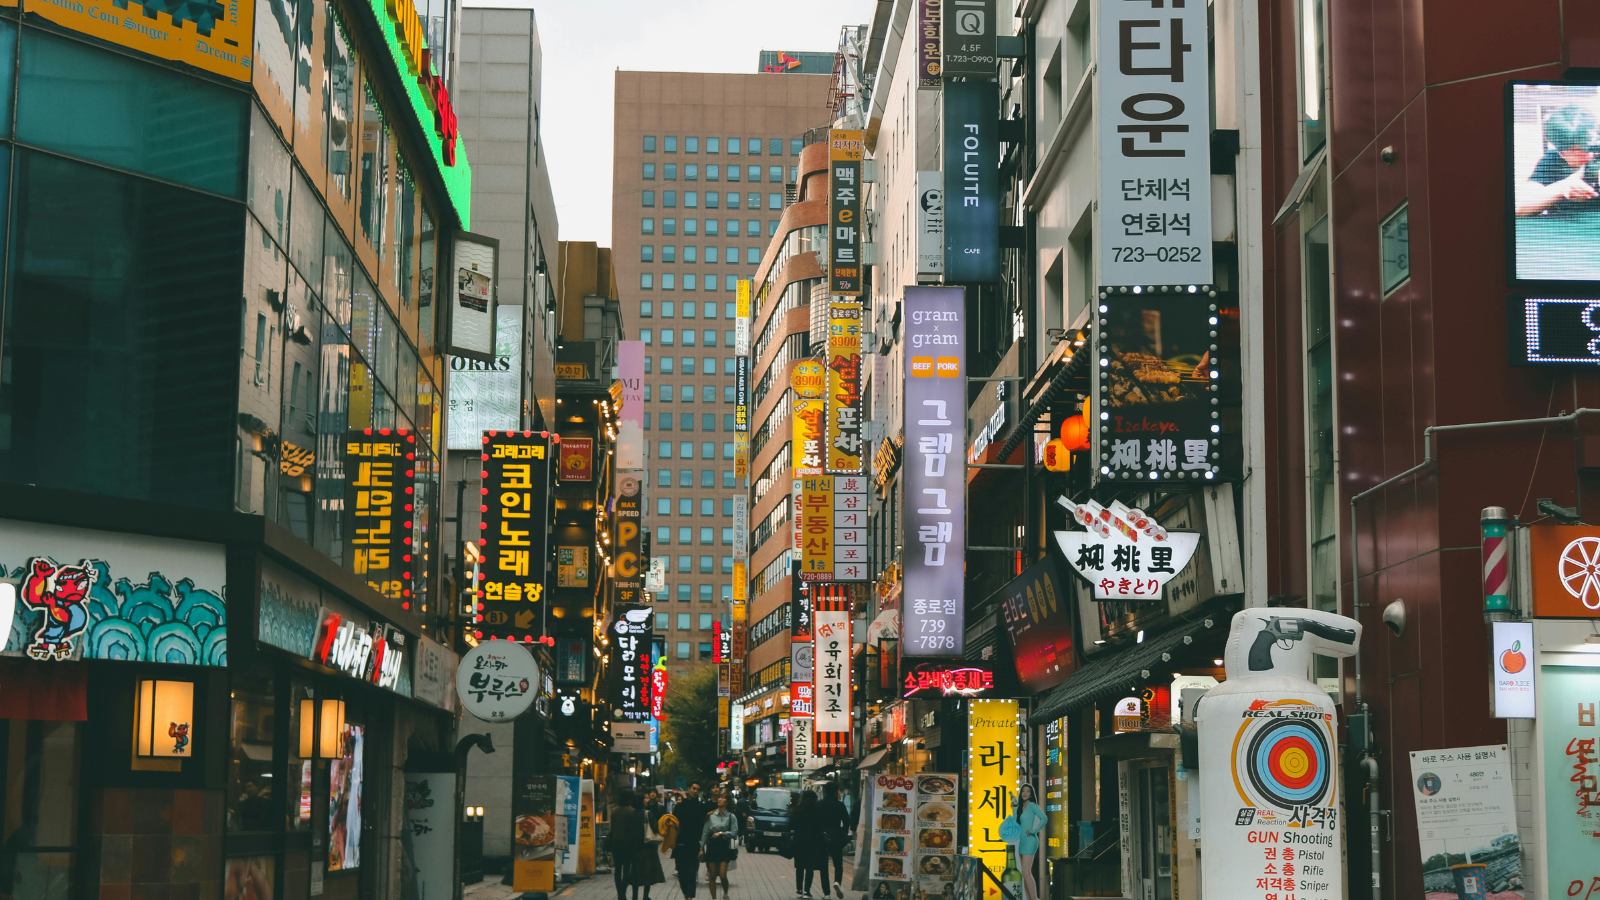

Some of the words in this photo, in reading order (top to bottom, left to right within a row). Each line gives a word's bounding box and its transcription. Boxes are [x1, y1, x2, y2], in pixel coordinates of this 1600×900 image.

[88, 6, 119, 26] Coin
[123, 17, 169, 42] Singer
[196, 39, 238, 64] Dream
[960, 44, 981, 52] 4.5F
[946, 55, 994, 63] T.723-0990
[1117, 0, 1192, 158] 타운
[833, 140, 861, 150] 최저가
[963, 124, 980, 208] FOLUITE
[1121, 178, 1190, 201] 단체석
[835, 167, 857, 263] 맥주e마트
[1121, 212, 1191, 236] 연회석
[1111, 246, 1202, 263] 723-0252
[912, 310, 959, 325] gram
[912, 333, 959, 348] gram
[913, 362, 932, 370] BEEF
[937, 362, 958, 370] PORK
[492, 444, 545, 460] 고래고래
[805, 479, 831, 492] 대신
[917, 400, 953, 566] 그램그램
[498, 464, 533, 576] 코인노래
[805, 495, 829, 556] 부동산
[485, 581, 543, 602] 연습장
[1098, 577, 1160, 596] やきとり
[621, 591, 633, 600] 3F
[913, 599, 956, 615] 종로점
[920, 620, 946, 633] 739
[913, 636, 955, 649] -7878
[824, 641, 842, 718] 육회지존
[972, 716, 1016, 728] Private
[1118, 717, 1142, 729] Klou
[1242, 711, 1286, 719] REAL
[1288, 711, 1324, 719] SHOT
[795, 720, 807, 768] 황소곱창
[1422, 756, 1437, 764] 바로
[1439, 754, 1454, 763] 주스
[1457, 752, 1472, 761] 사용
[1474, 751, 1497, 760] 설명서
[978, 741, 1011, 853] 라세느
[1257, 819, 1287, 827] Reaction
[1288, 807, 1337, 831] 사격장
[1247, 831, 1279, 843] GUN
[1283, 832, 1333, 847] Shooting
[1264, 848, 1295, 861] 권총
[1299, 850, 1324, 860] Pistol
[1264, 863, 1295, 876] 소총
[1303, 865, 1324, 876] Rifle
[1256, 878, 1296, 892] 저격총
[1300, 880, 1329, 893] Sniper
